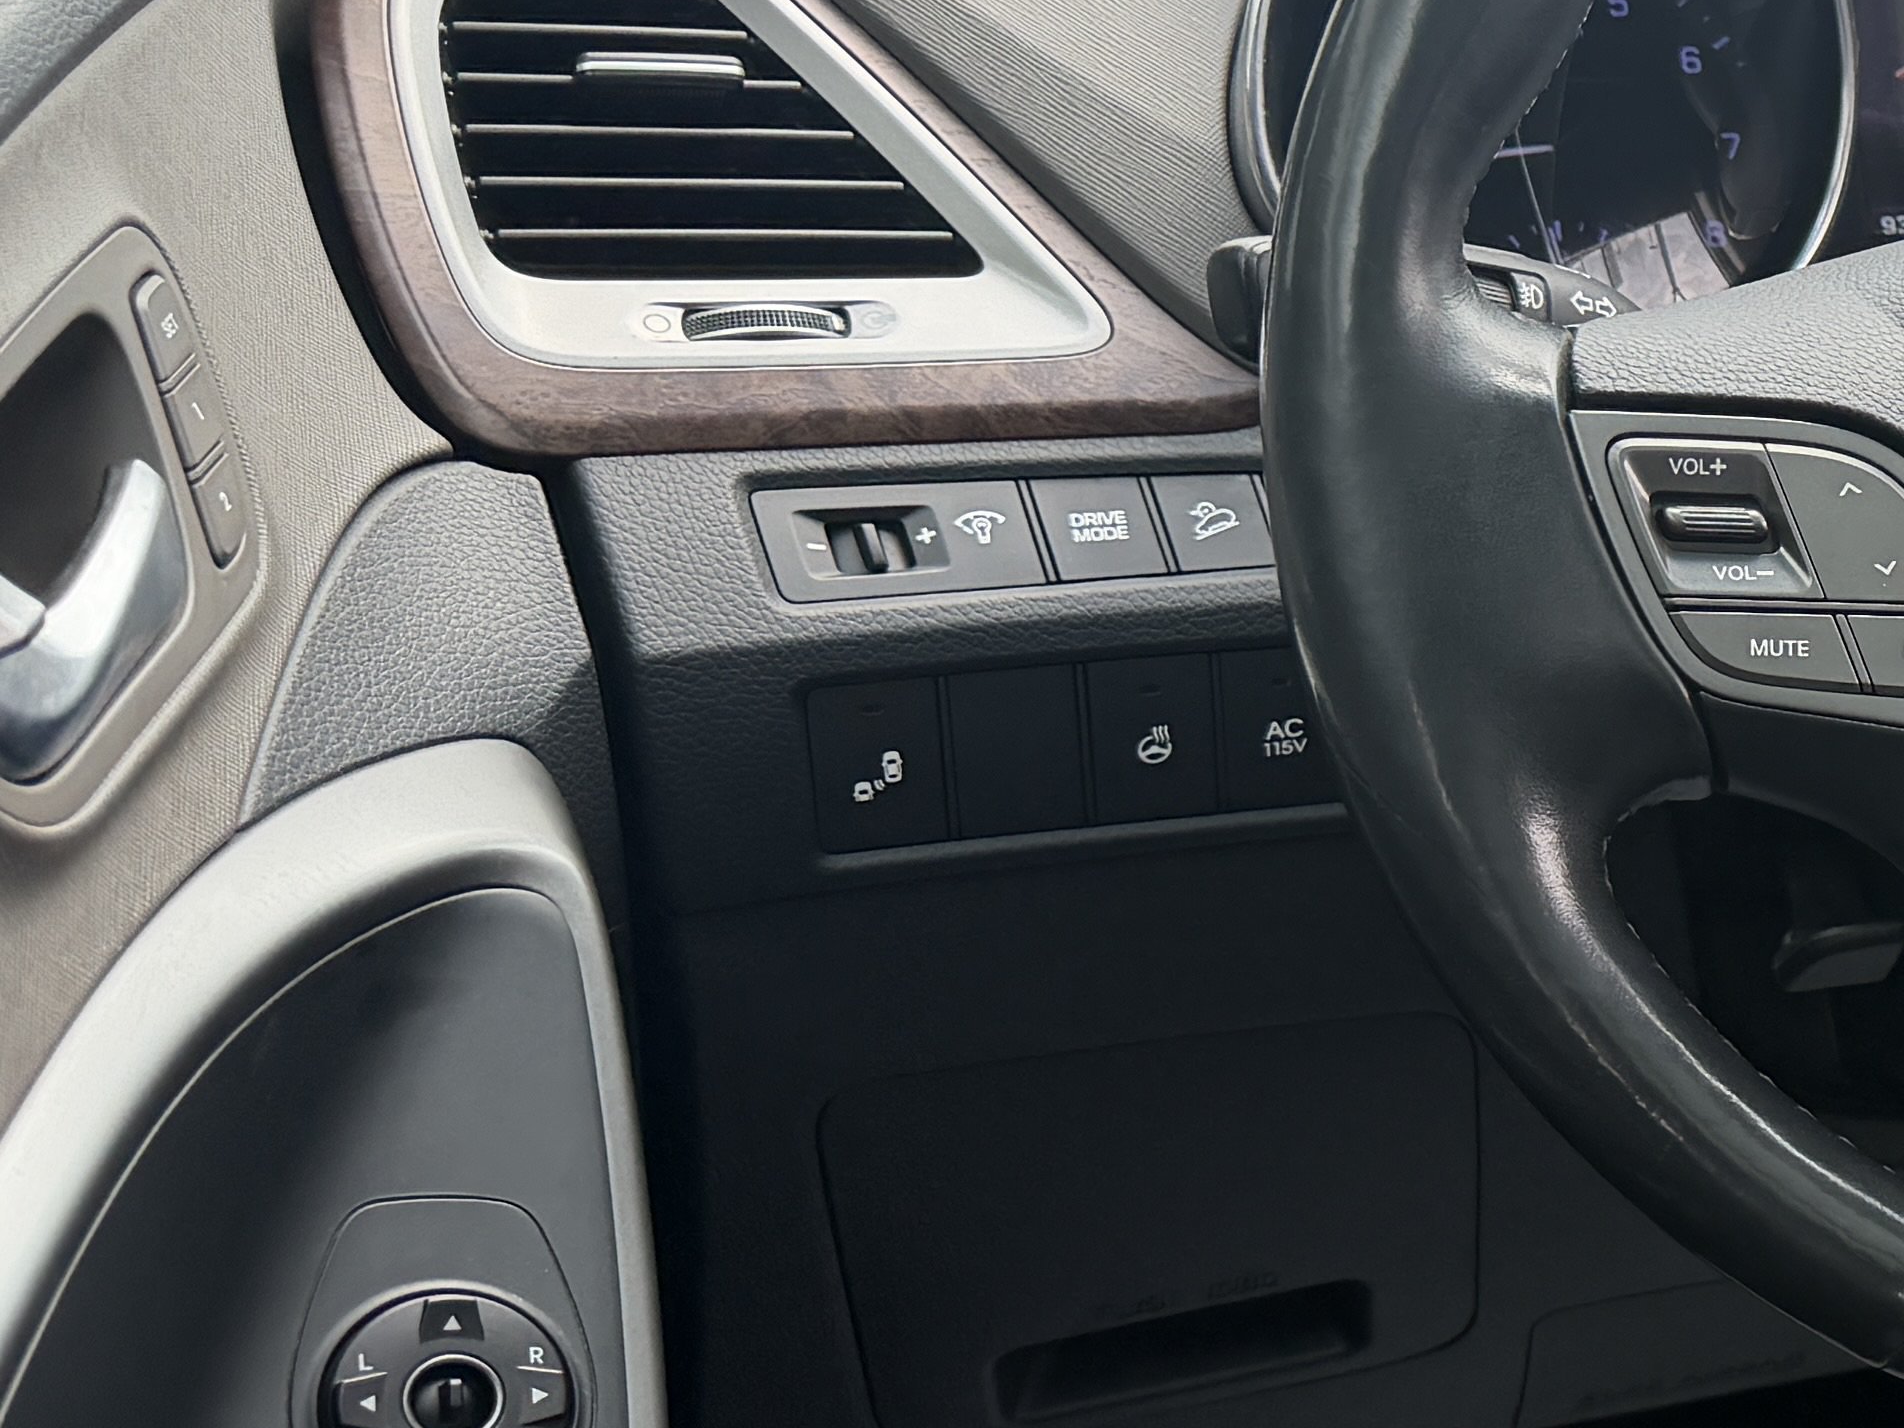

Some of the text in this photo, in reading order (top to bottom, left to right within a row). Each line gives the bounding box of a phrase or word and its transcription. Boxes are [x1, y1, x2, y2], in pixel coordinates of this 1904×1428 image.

[1678, 44, 1702, 76] 6
[1719, 131, 1743, 162] 7
[191, 402, 205, 421] 1
[1668, 456, 1728, 477] VOL+
[218, 491, 232, 512] 2
[1069, 509, 1128, 529] DRIVE
[1070, 523, 1131, 544] MODE
[1750, 637, 1810, 658] MUTE
[1264, 718, 1304, 739] AC
[1263, 736, 1308, 758] 115V
[357, 1353, 375, 1371] L
[528, 1346, 545, 1365] R
